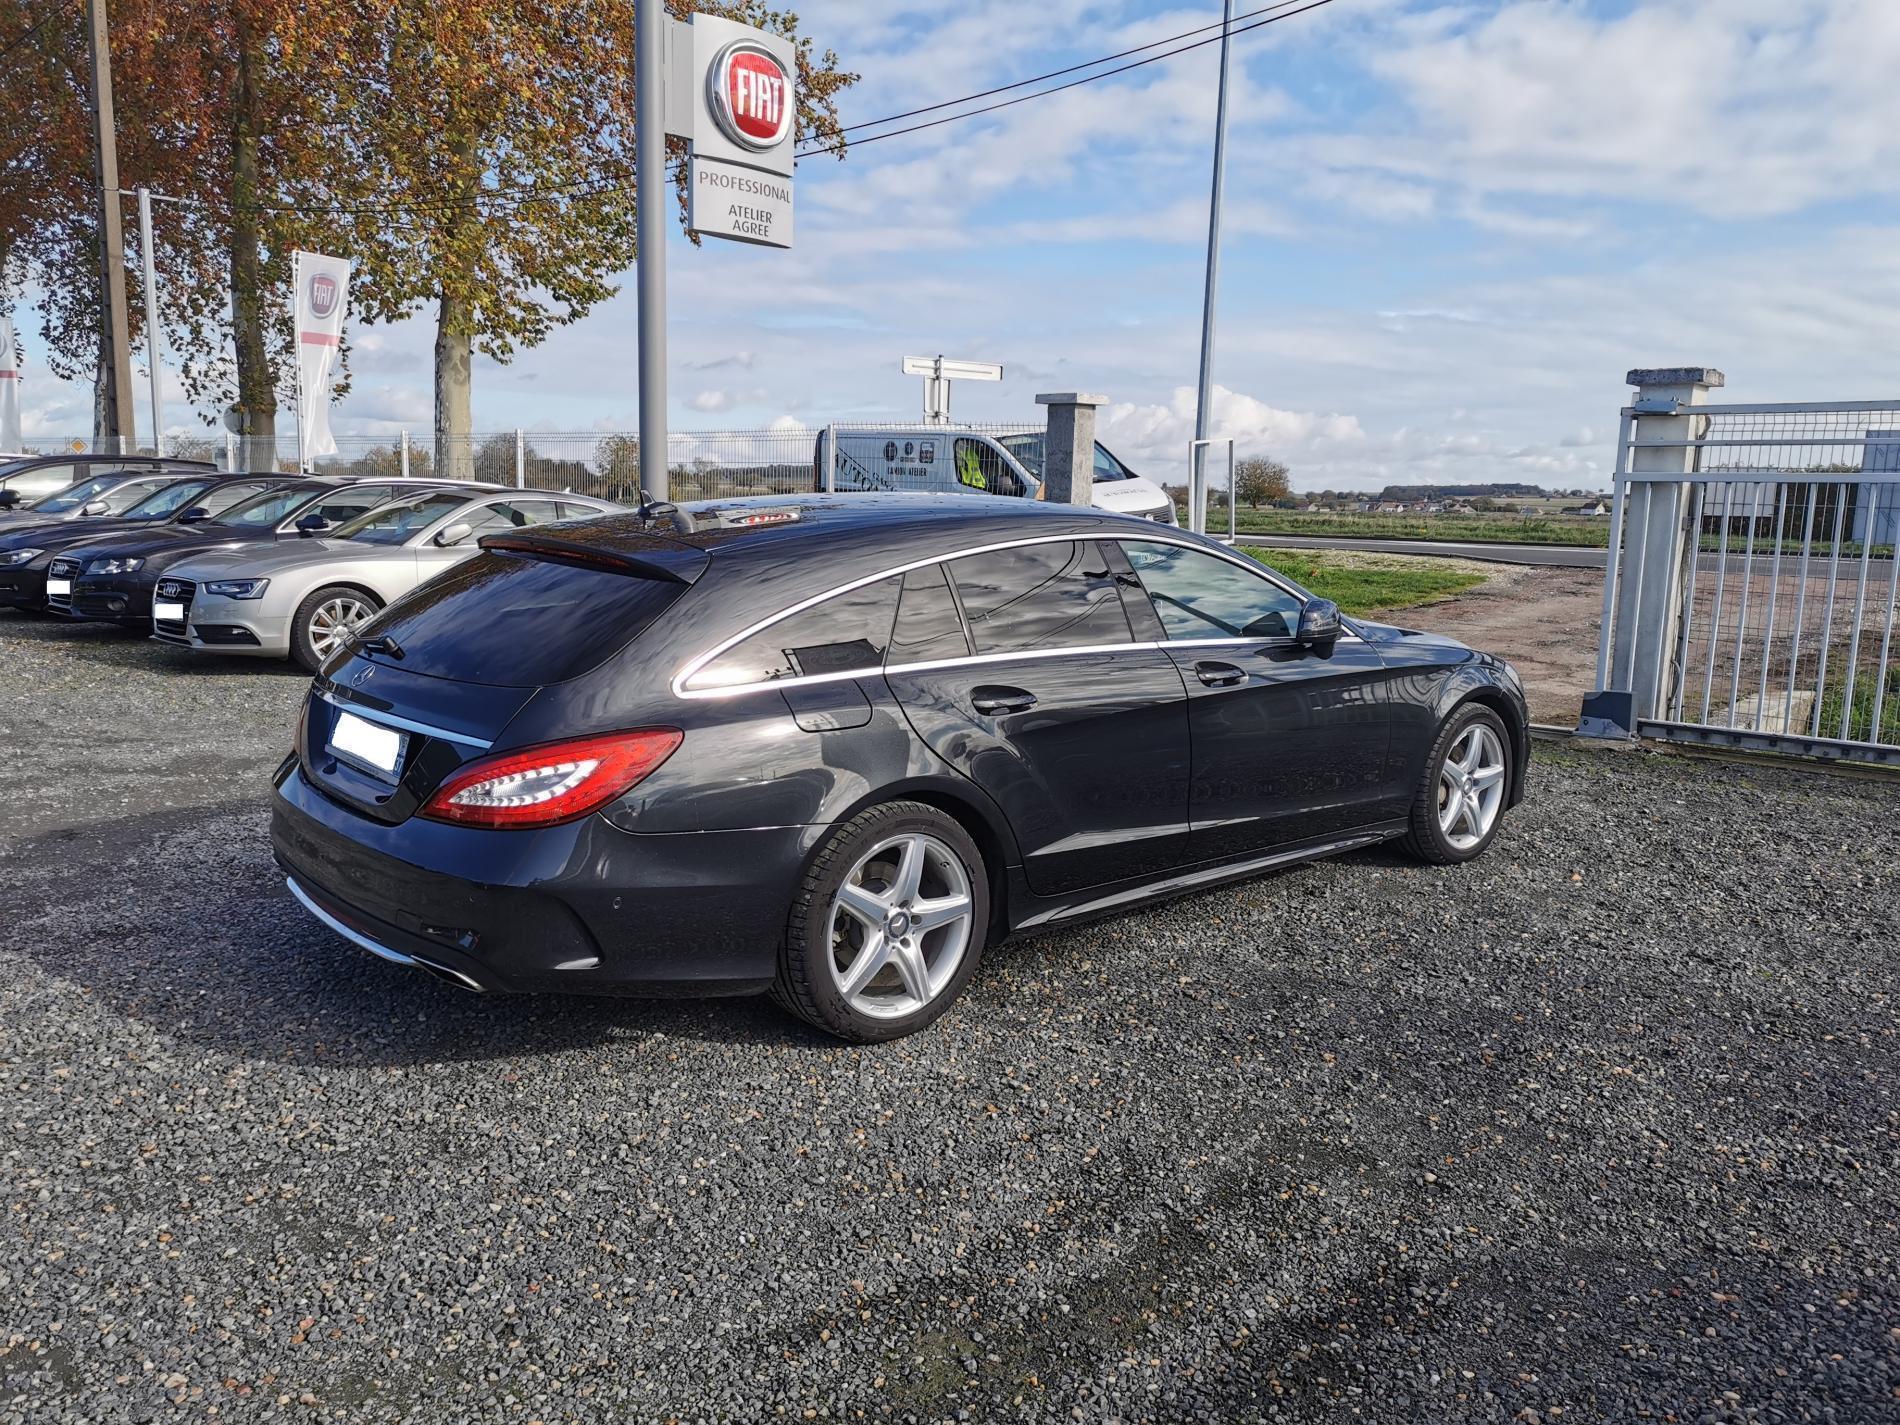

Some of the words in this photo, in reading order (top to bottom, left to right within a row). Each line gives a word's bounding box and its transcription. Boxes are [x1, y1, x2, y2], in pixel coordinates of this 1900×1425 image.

[736, 67, 782, 124] FIAT
[699, 171, 791, 204] PROFESSIONAL
[728, 204, 773, 225] ATELIER
[732, 219, 770, 238] AGREE
[313, 283, 333, 305] FIAT
